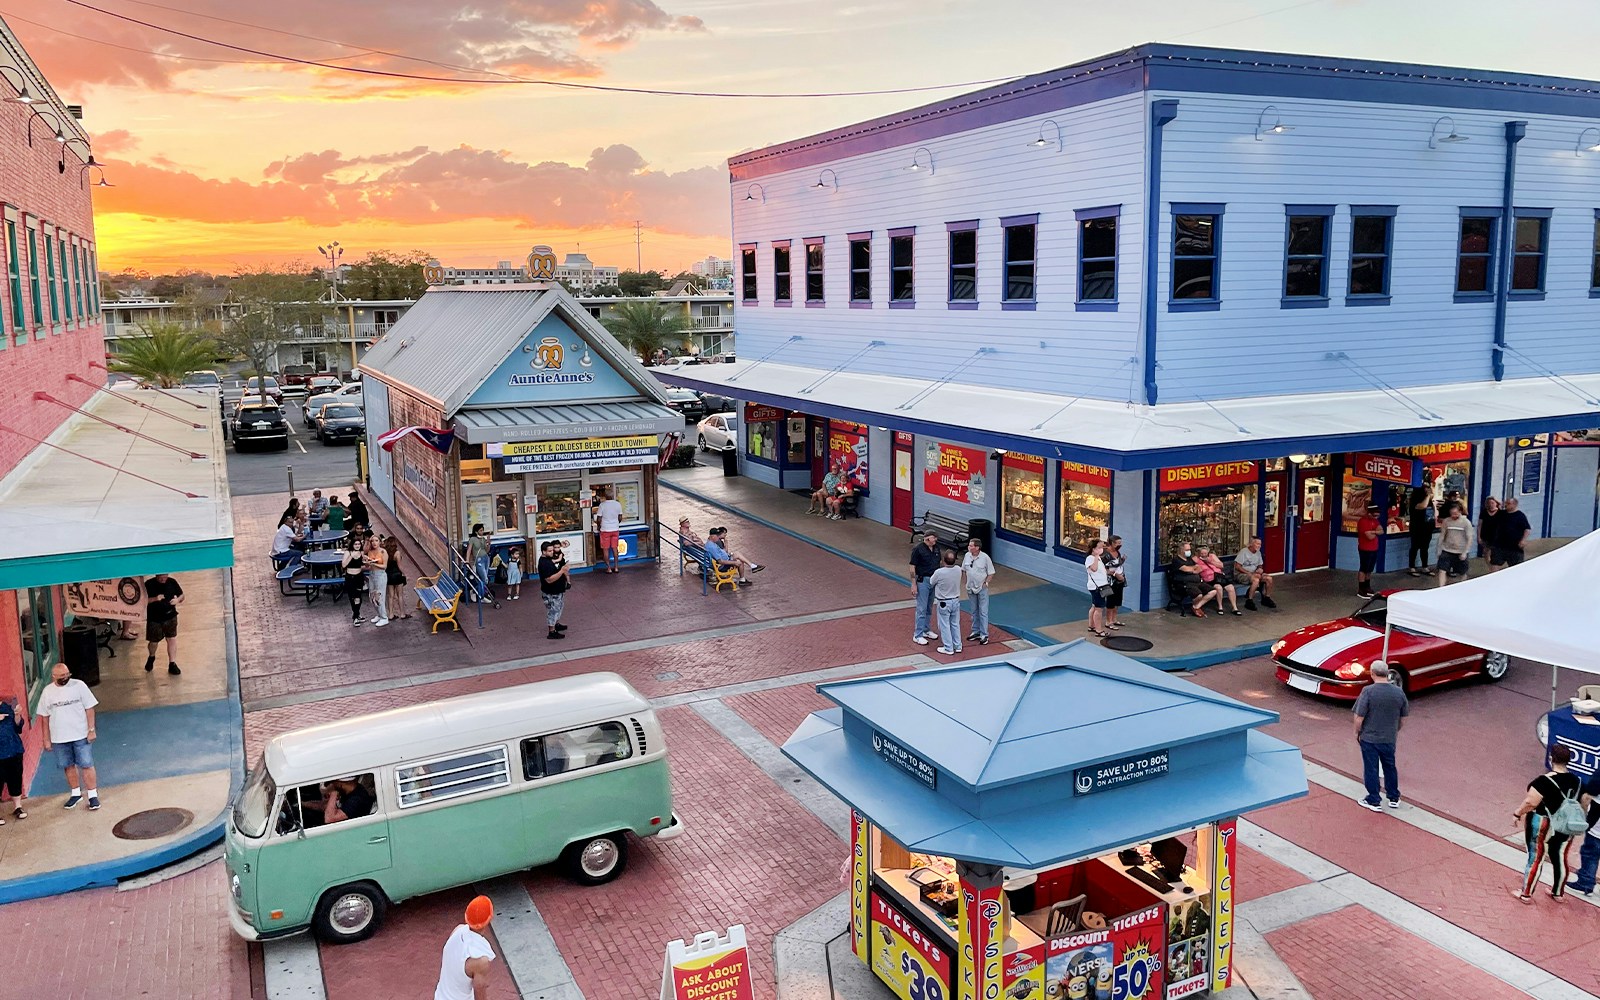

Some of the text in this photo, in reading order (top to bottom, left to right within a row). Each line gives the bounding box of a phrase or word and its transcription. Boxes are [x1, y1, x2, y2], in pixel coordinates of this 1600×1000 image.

[753, 410, 776, 418] GIFTS
[898, 432, 912, 441] GIFTS
[513, 444, 546, 454] CHEAPEST
[556, 442, 583, 451] COLDEST
[585, 440, 600, 449] BEER
[603, 440, 610, 448] IN
[612, 439, 623, 447] OLD
[830, 438, 851, 453] GIFTS
[1438, 441, 1467, 453] GIFTS
[940, 452, 968, 472] GIFTS
[1064, 461, 1109, 478] DISNEY GIFTS
[1365, 461, 1402, 476] GIFTS
[1168, 462, 1250, 482] DISNEY GIFTS
[942, 474, 968, 486] Welcomes
[948, 486, 961, 497] You!
[92, 592, 118, 602] Around
[884, 740, 932, 776] SAVE UP TO 80%
[890, 754, 914, 772] ATTRACTION
[915, 769, 932, 784] TICKETS
[1097, 754, 1168, 779] SAVE UP TO 80%
[1108, 771, 1144, 784] ATTRACTION
[1145, 764, 1168, 775] TICKETS
[1217, 828, 1233, 980] TICKETS
[1125, 948, 1146, 961] UP TO
[682, 963, 742, 988] ASK ABOUT
[687, 976, 740, 999] DISCOUNT
[701, 990, 737, 1000] CKETS
